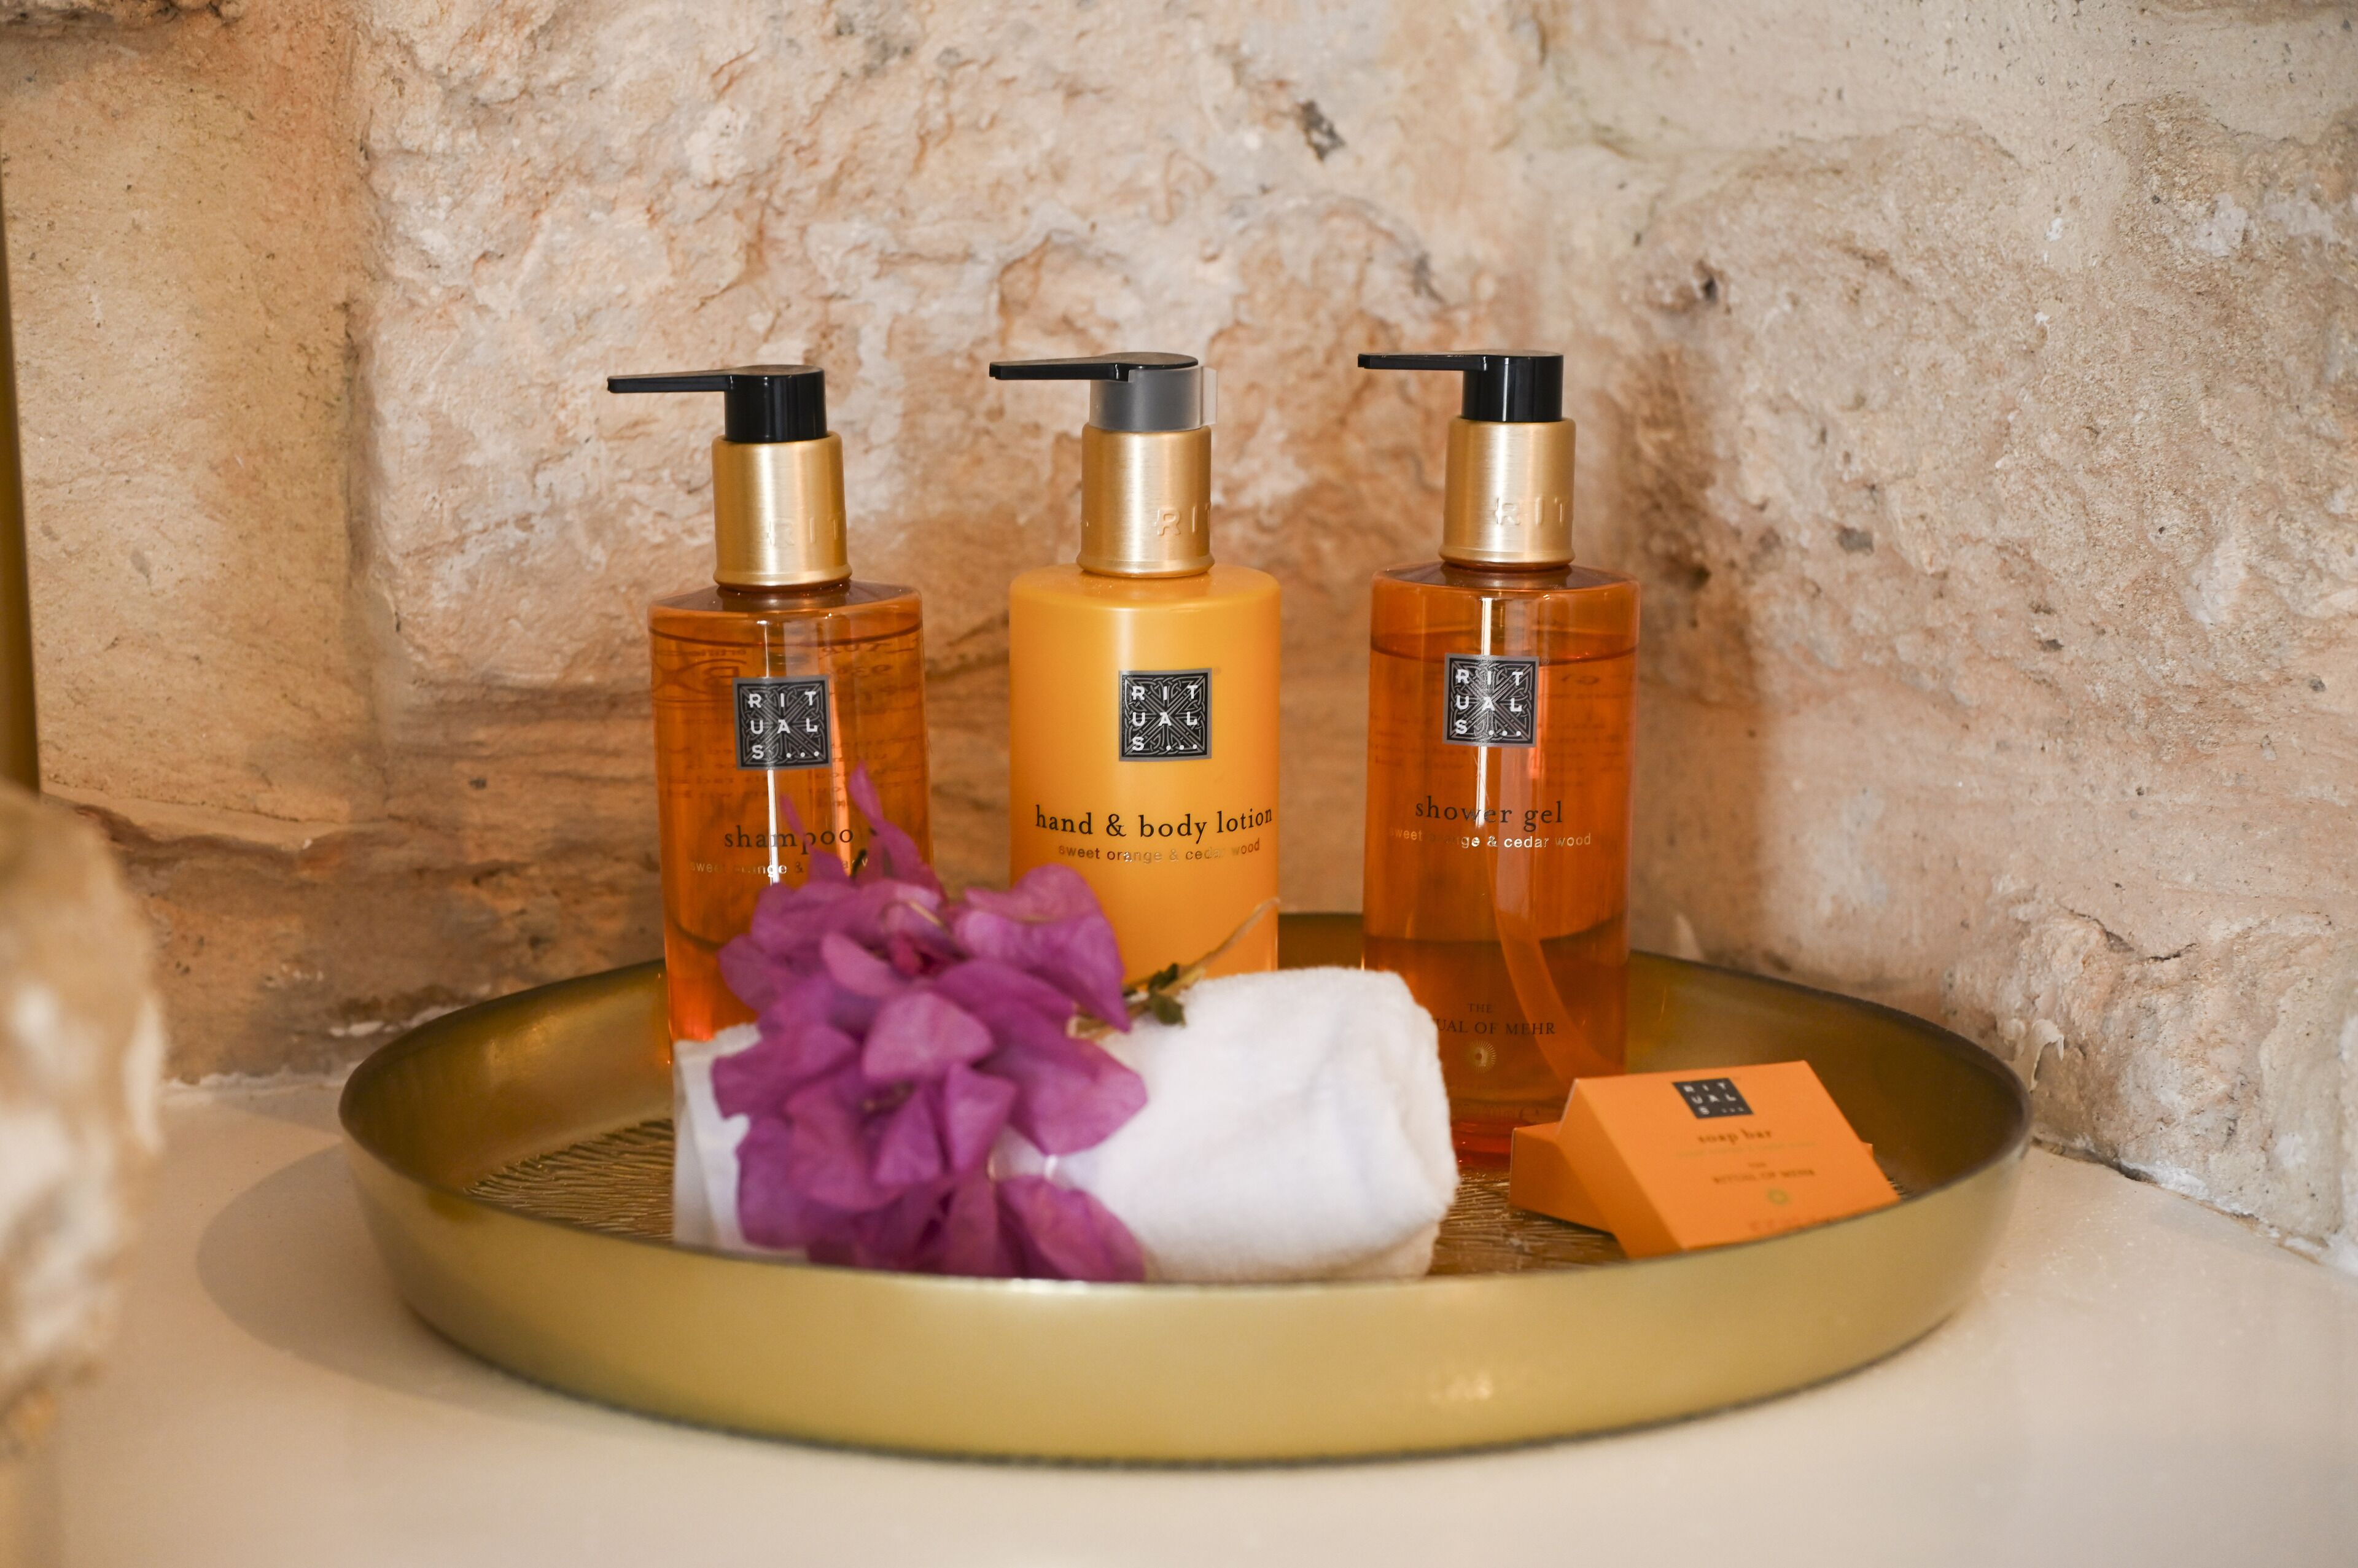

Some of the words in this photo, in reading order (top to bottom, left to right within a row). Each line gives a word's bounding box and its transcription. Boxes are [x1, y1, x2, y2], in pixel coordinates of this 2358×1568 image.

[1035, 804, 1093, 835] hand
[1106, 813, 1127, 837] &
[1138, 813, 1207, 845] body
[1216, 808, 1272, 834] lotion
[1415, 795, 1512, 823] shower
[1523, 801, 1563, 833] gel
[724, 825, 854, 855] shampoo
[1058, 844, 1100, 860] sweet
[1107, 850, 1162, 864] orange
[1169, 848, 1179, 862] &
[1185, 846, 1225, 861] cedar
[1231, 837, 1261, 856] wood
[1487, 835, 1498, 848] &
[1504, 836, 1549, 848] cedar
[1555, 832, 1591, 847] wood
[1467, 1003, 1493, 1014] THE
[1434, 1018, 1469, 1034] UAL
[1474, 1021, 1499, 1034] OF
[1505, 1022, 1556, 1036] MEHR
